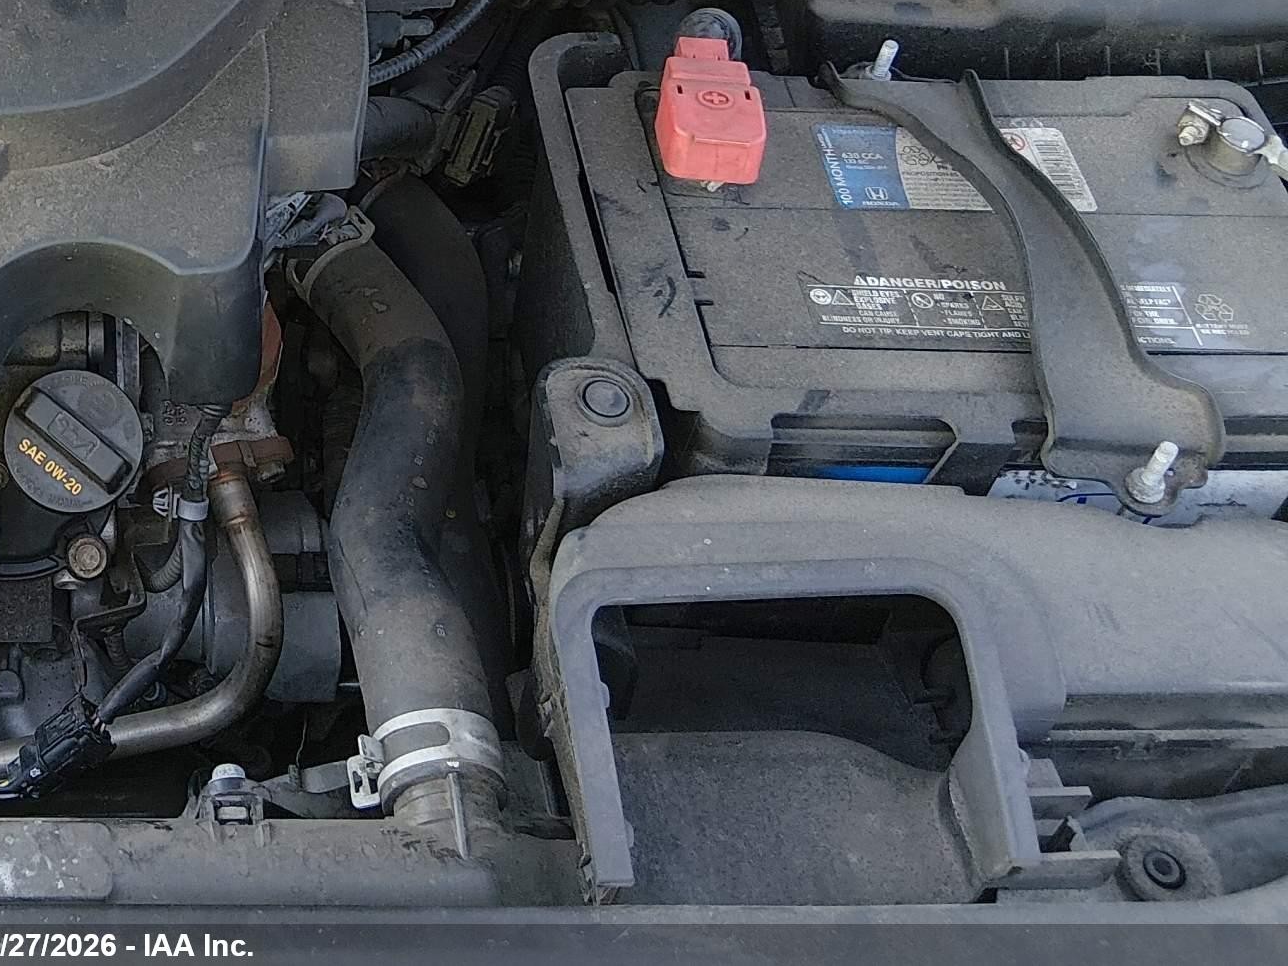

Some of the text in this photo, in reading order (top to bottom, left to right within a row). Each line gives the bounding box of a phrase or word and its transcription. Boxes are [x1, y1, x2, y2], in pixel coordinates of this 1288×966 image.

[822, 148, 847, 187] MONTH
[838, 187, 854, 205] 100
[866, 276, 1007, 292] DANGER/POISON
[18, 438, 47, 466] SAE
[44, 459, 82, 496] 0W-20
